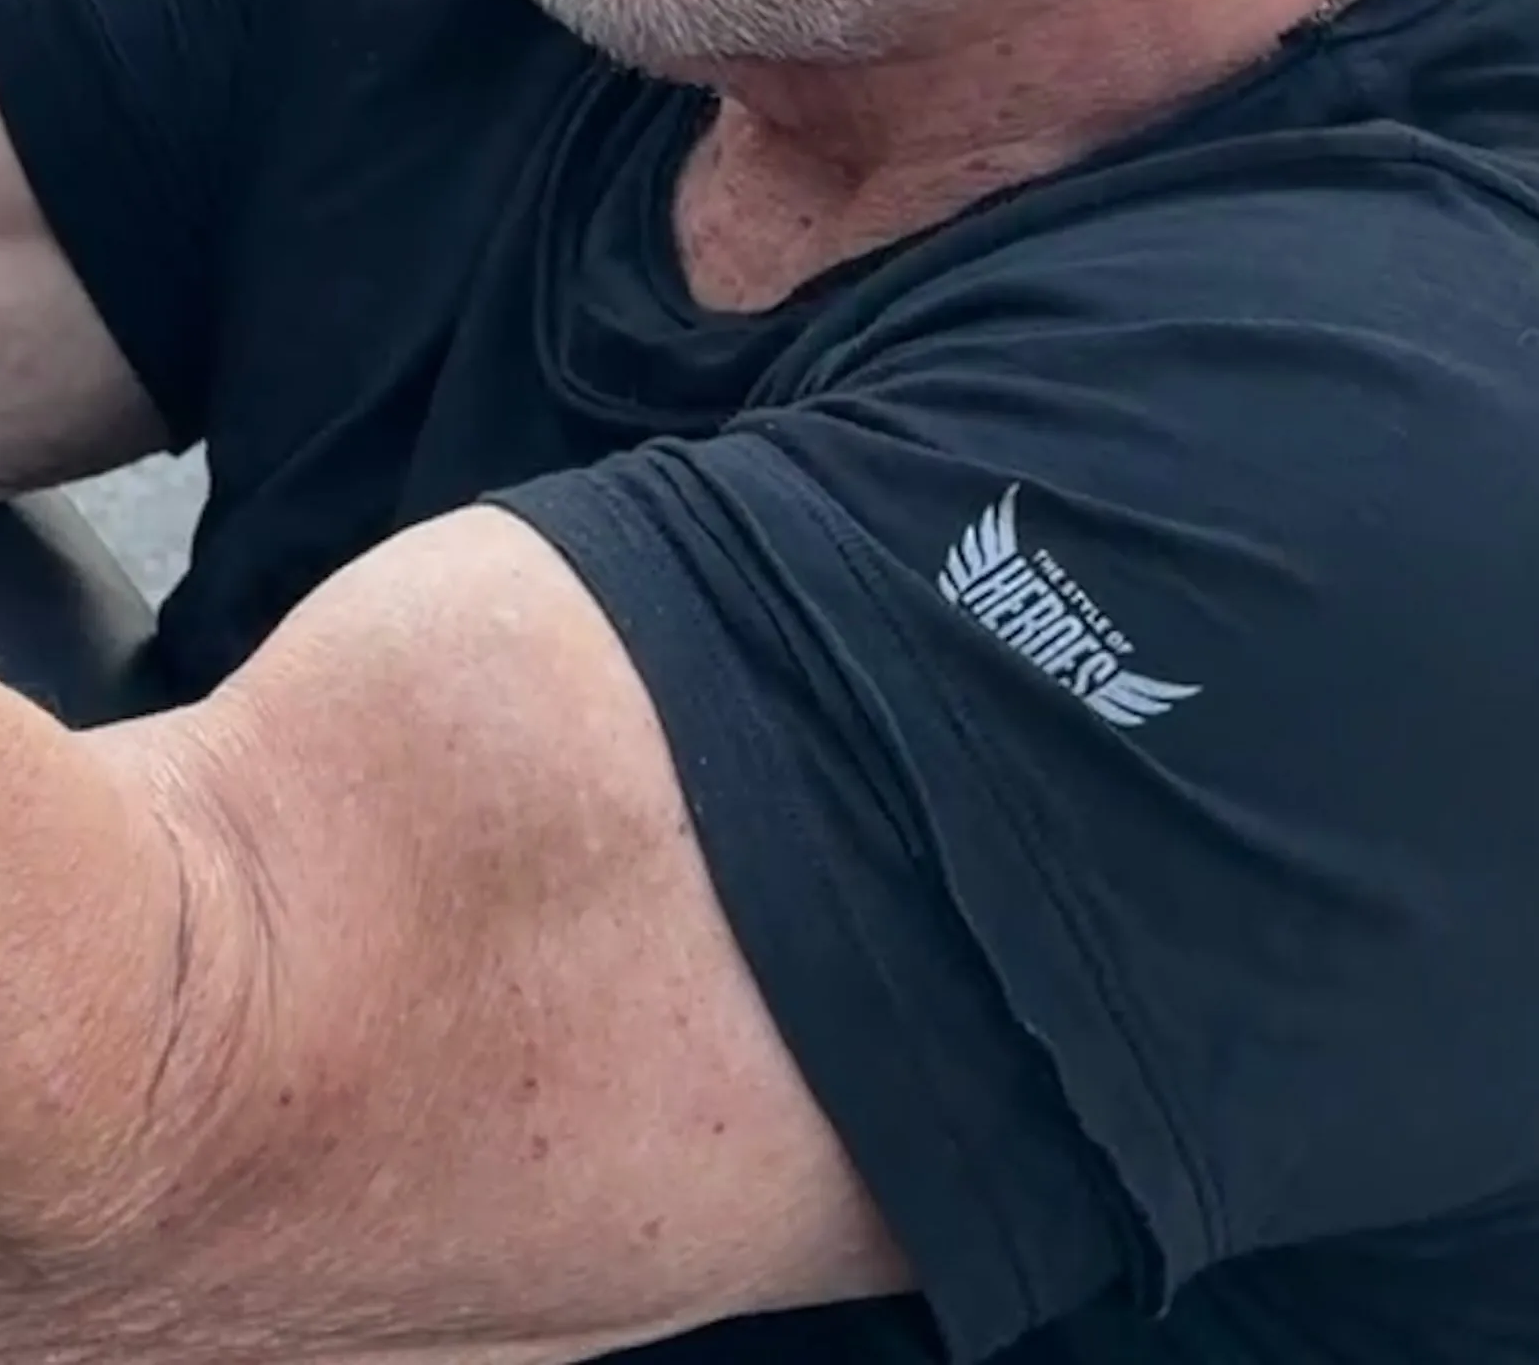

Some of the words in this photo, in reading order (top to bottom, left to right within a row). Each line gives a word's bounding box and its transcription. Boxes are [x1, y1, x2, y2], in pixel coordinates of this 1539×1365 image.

[961, 556, 1119, 697] HEROES
[1032, 548, 1066, 585] THE
[1060, 580, 1114, 637] STYLE
[1104, 629, 1136, 656] OF
